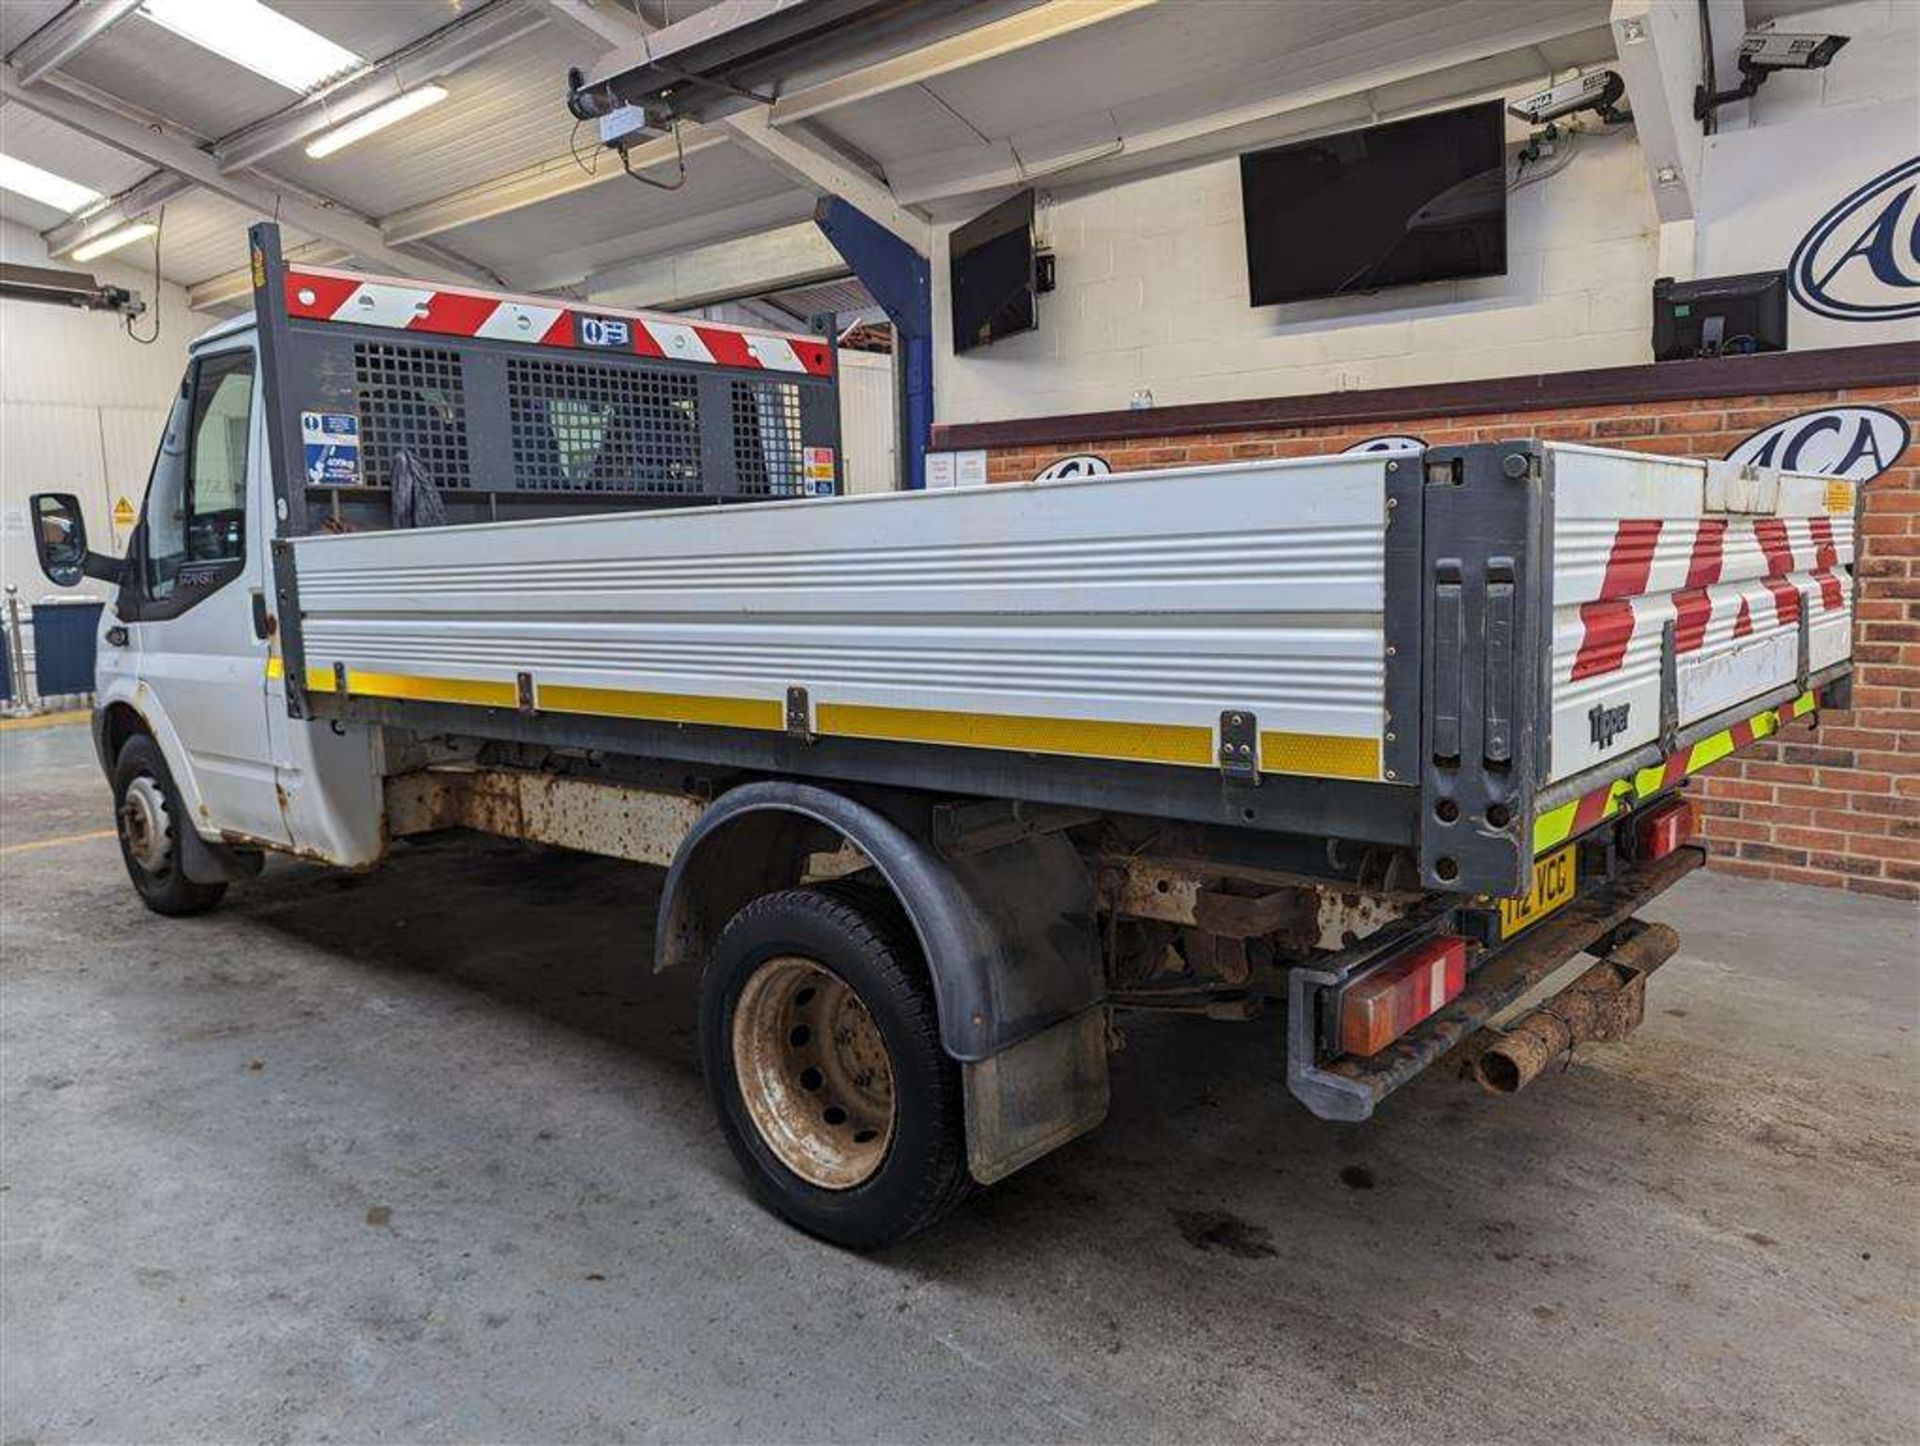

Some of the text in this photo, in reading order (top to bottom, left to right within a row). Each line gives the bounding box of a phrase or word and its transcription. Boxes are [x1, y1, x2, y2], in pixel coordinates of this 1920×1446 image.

[1747, 416, 1885, 476] ACA
[1588, 702, 1630, 750] Tipper
[1537, 853, 1566, 906] VCG
